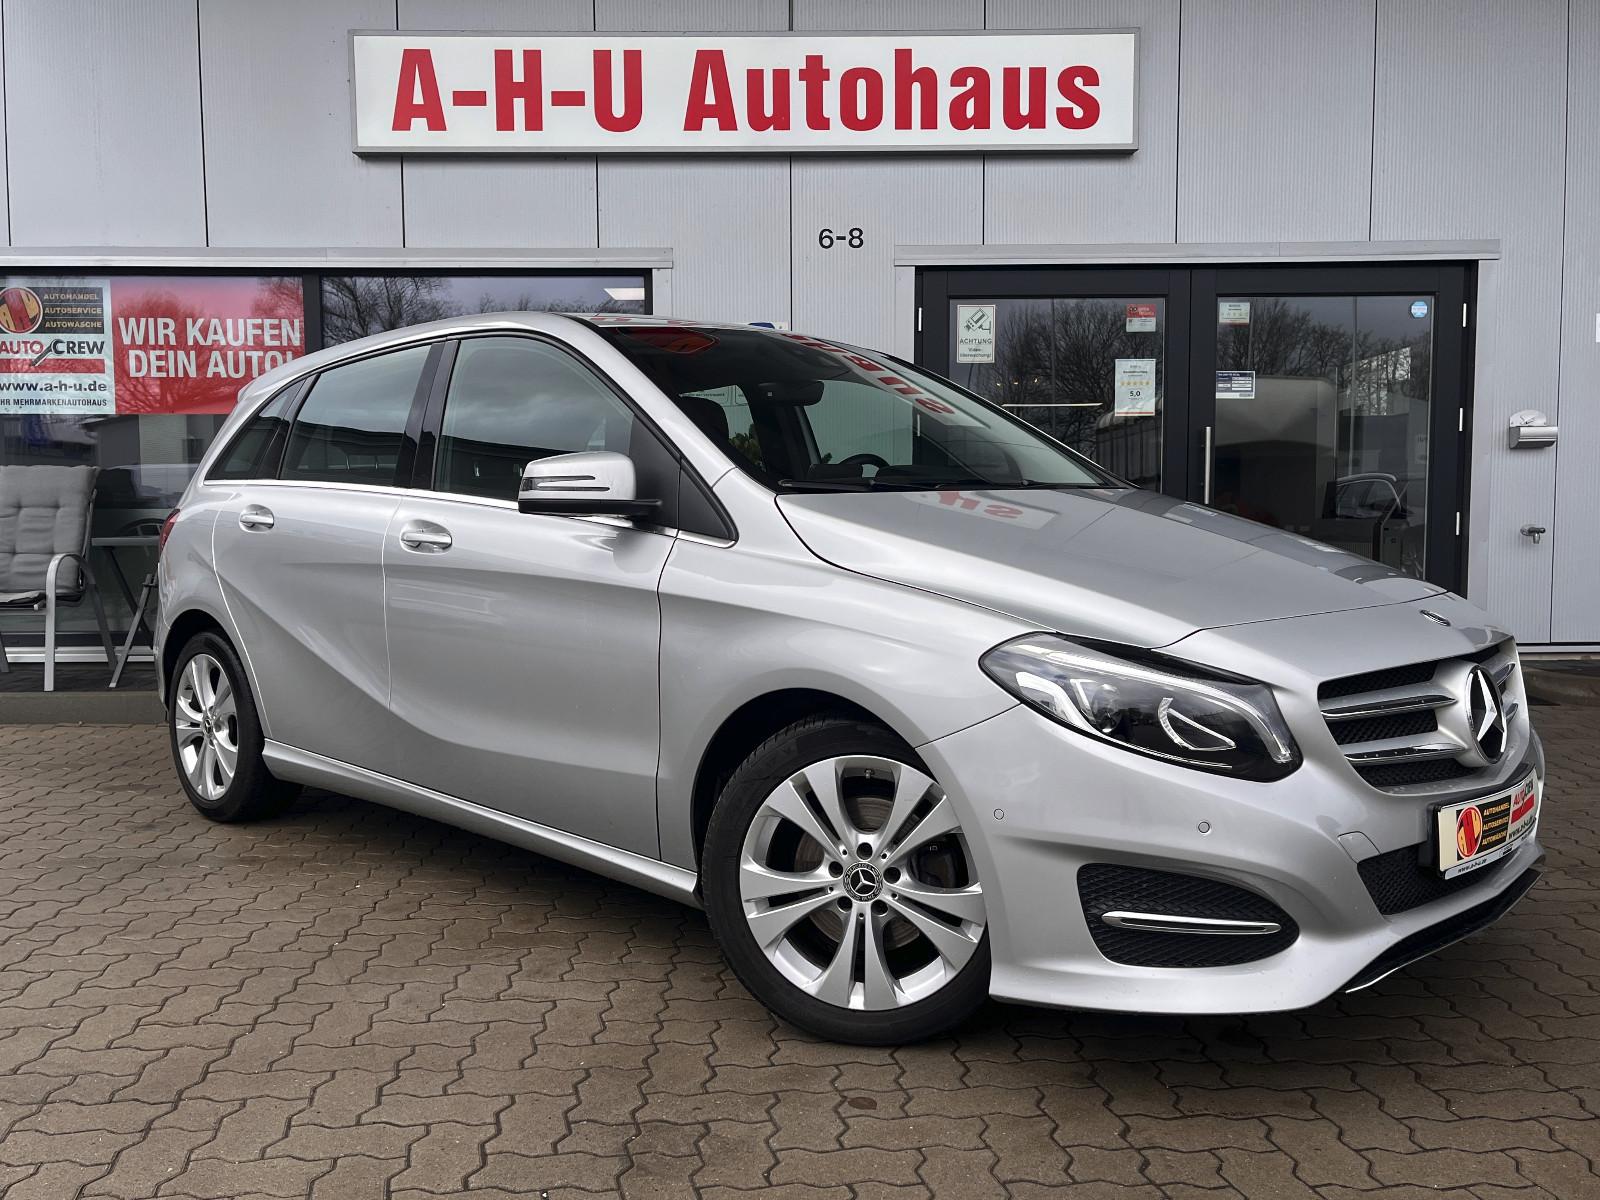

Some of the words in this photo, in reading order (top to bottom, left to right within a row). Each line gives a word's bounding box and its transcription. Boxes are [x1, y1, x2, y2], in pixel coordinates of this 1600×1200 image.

[392, 49, 643, 132] A-H-U
[684, 48, 1100, 132] Autohaus
[818, 228, 864, 249] 6-8
[118, 317, 176, 346] WIR
[186, 318, 300, 346] KAUFEN
[0, 340, 45, 355] AUTO
[52, 338, 105, 355] CREW
[128, 350, 197, 378] DEIN
[0, 380, 108, 392] www.a-h-u.de
[1129, 390, 1141, 398] 5,0
[13, 398, 107, 407] MEHRMARKENAUTOHAUS
